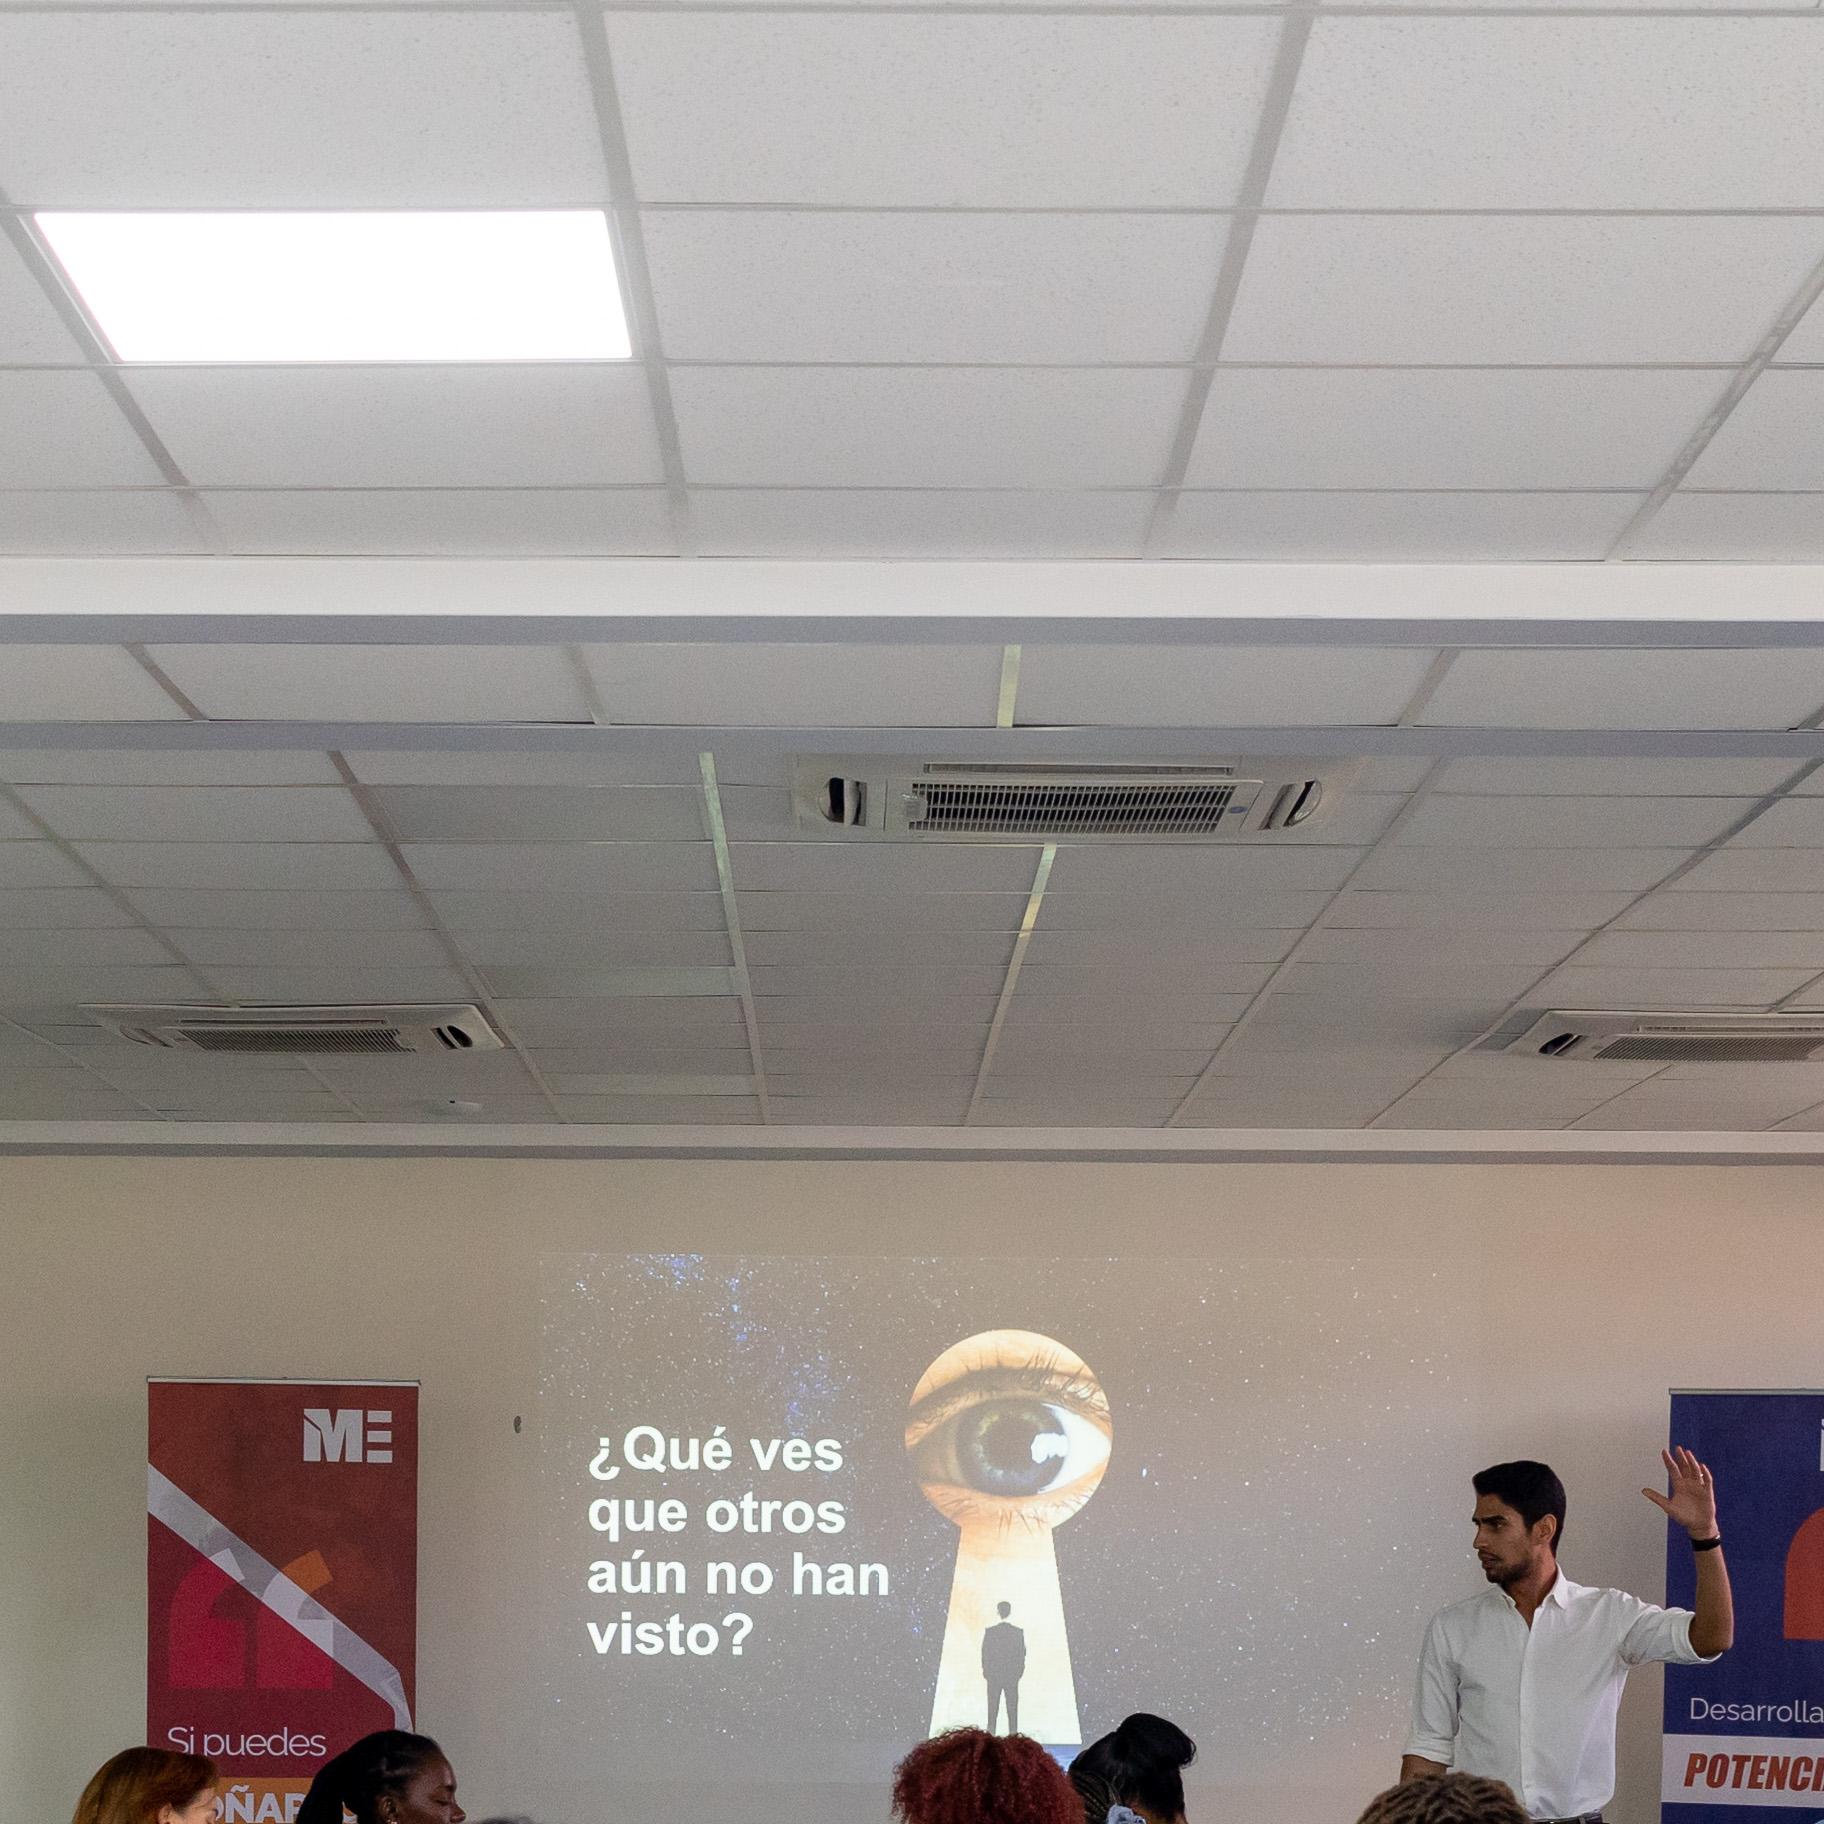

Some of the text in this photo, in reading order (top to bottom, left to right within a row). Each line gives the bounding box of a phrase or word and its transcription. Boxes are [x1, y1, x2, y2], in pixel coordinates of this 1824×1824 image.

[588, 1424, 844, 1482] ¿Qué ves
[587, 1490, 847, 1544] que otros
[586, 1548, 890, 1597] aún no han
[585, 1610, 755, 1657] visto?
[1689, 1697, 1824, 1724] Desarrolla
[167, 1726, 327, 1757] Si puedes
